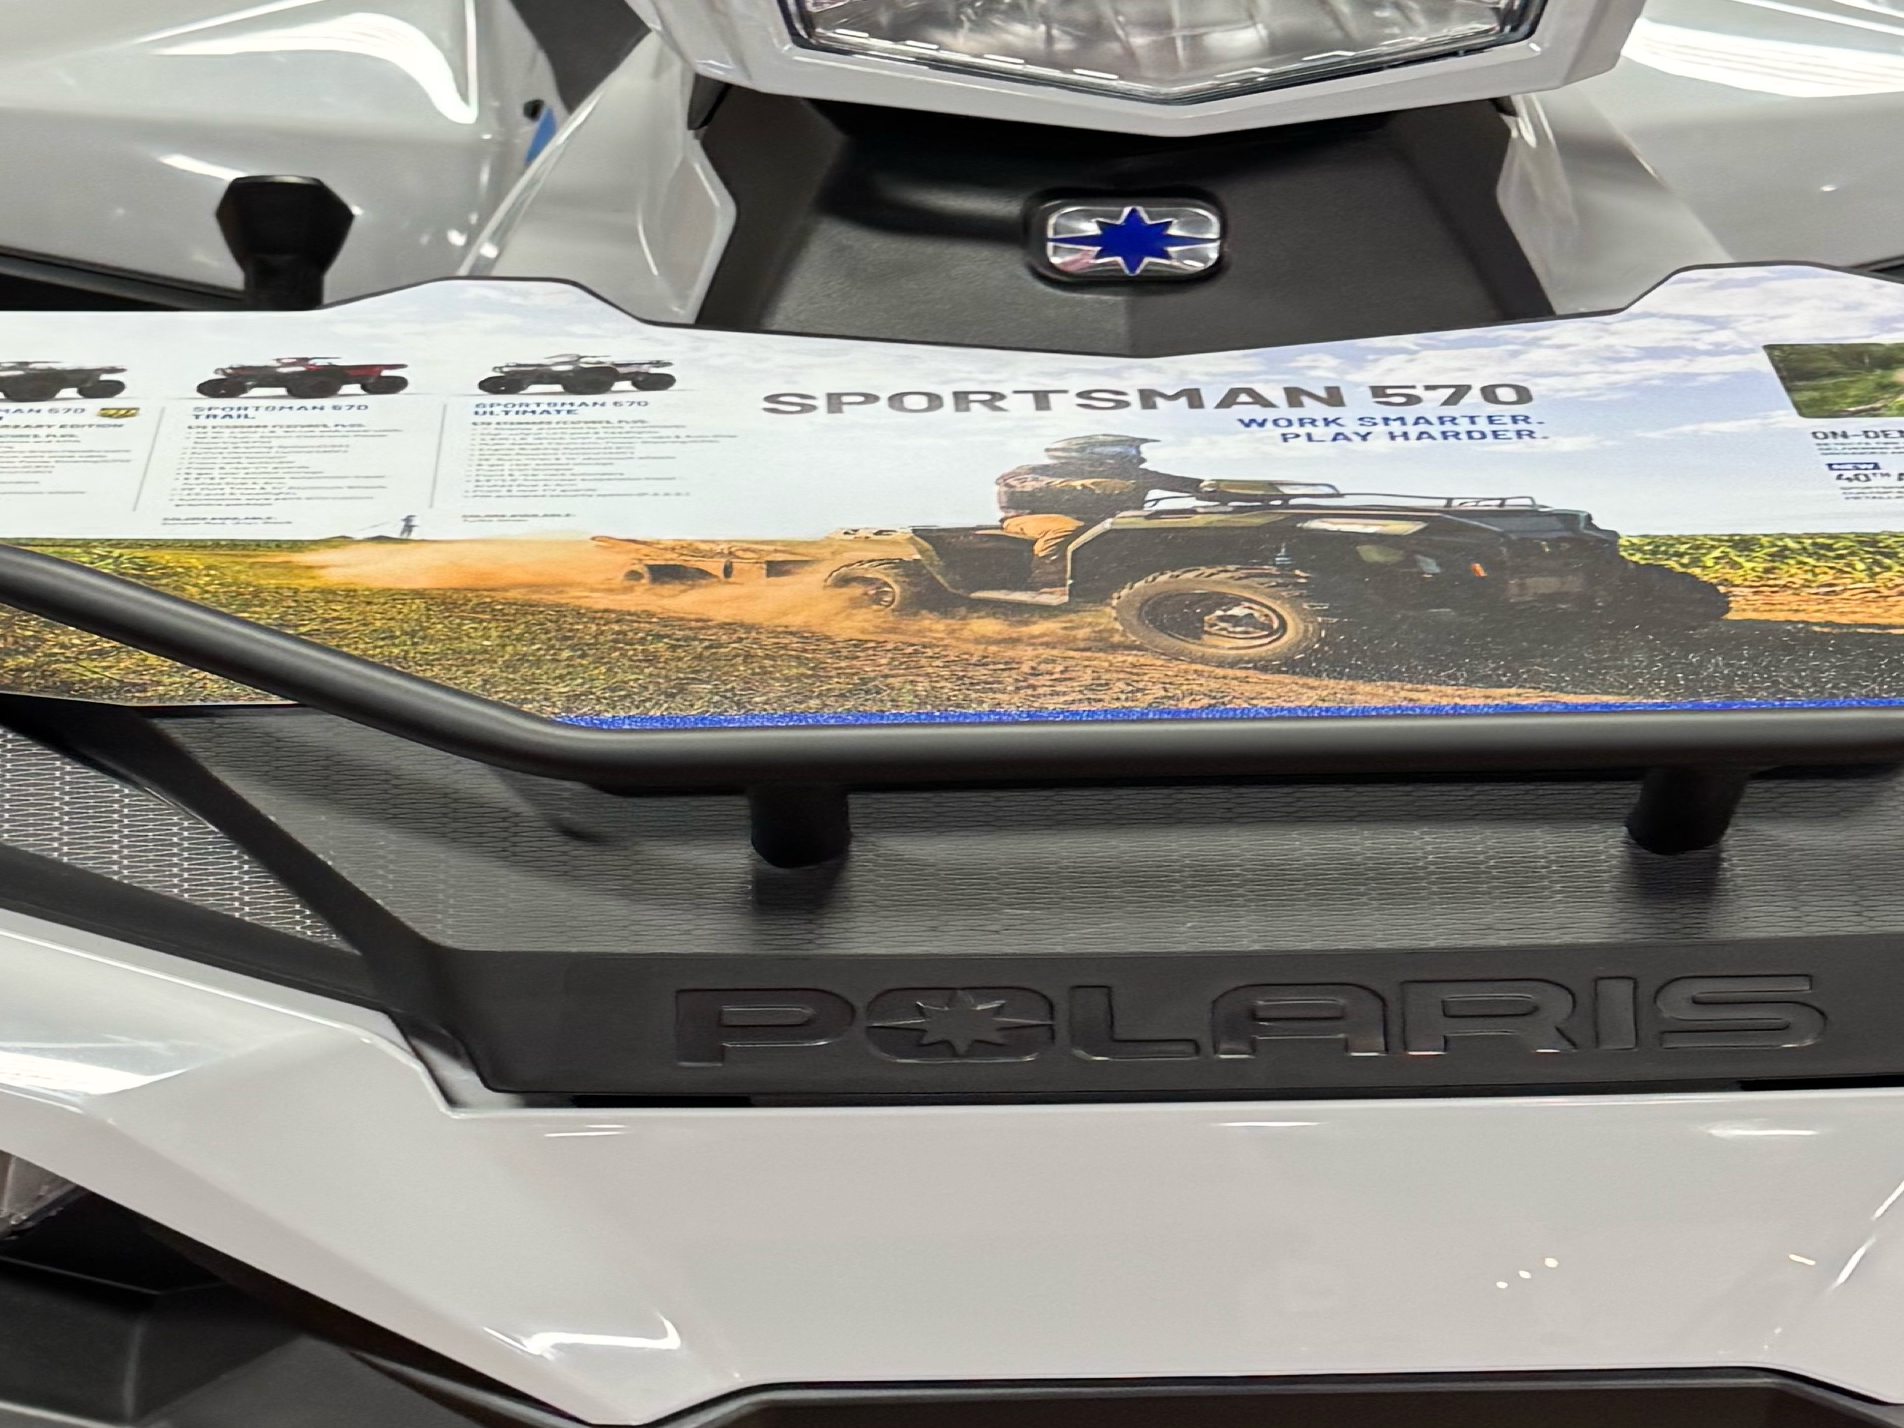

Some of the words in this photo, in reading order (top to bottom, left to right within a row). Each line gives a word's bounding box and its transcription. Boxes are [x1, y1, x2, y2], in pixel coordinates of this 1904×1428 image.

[761, 384, 1349, 416] SPORTSMAN
[1368, 383, 1536, 408] 570
[1238, 416, 1347, 430] WORK
[1357, 413, 1547, 428] SMARTER.
[1280, 431, 1379, 444] PLAY
[1388, 428, 1550, 443] HARDER.
[673, 973, 1834, 1069] POLARIS
